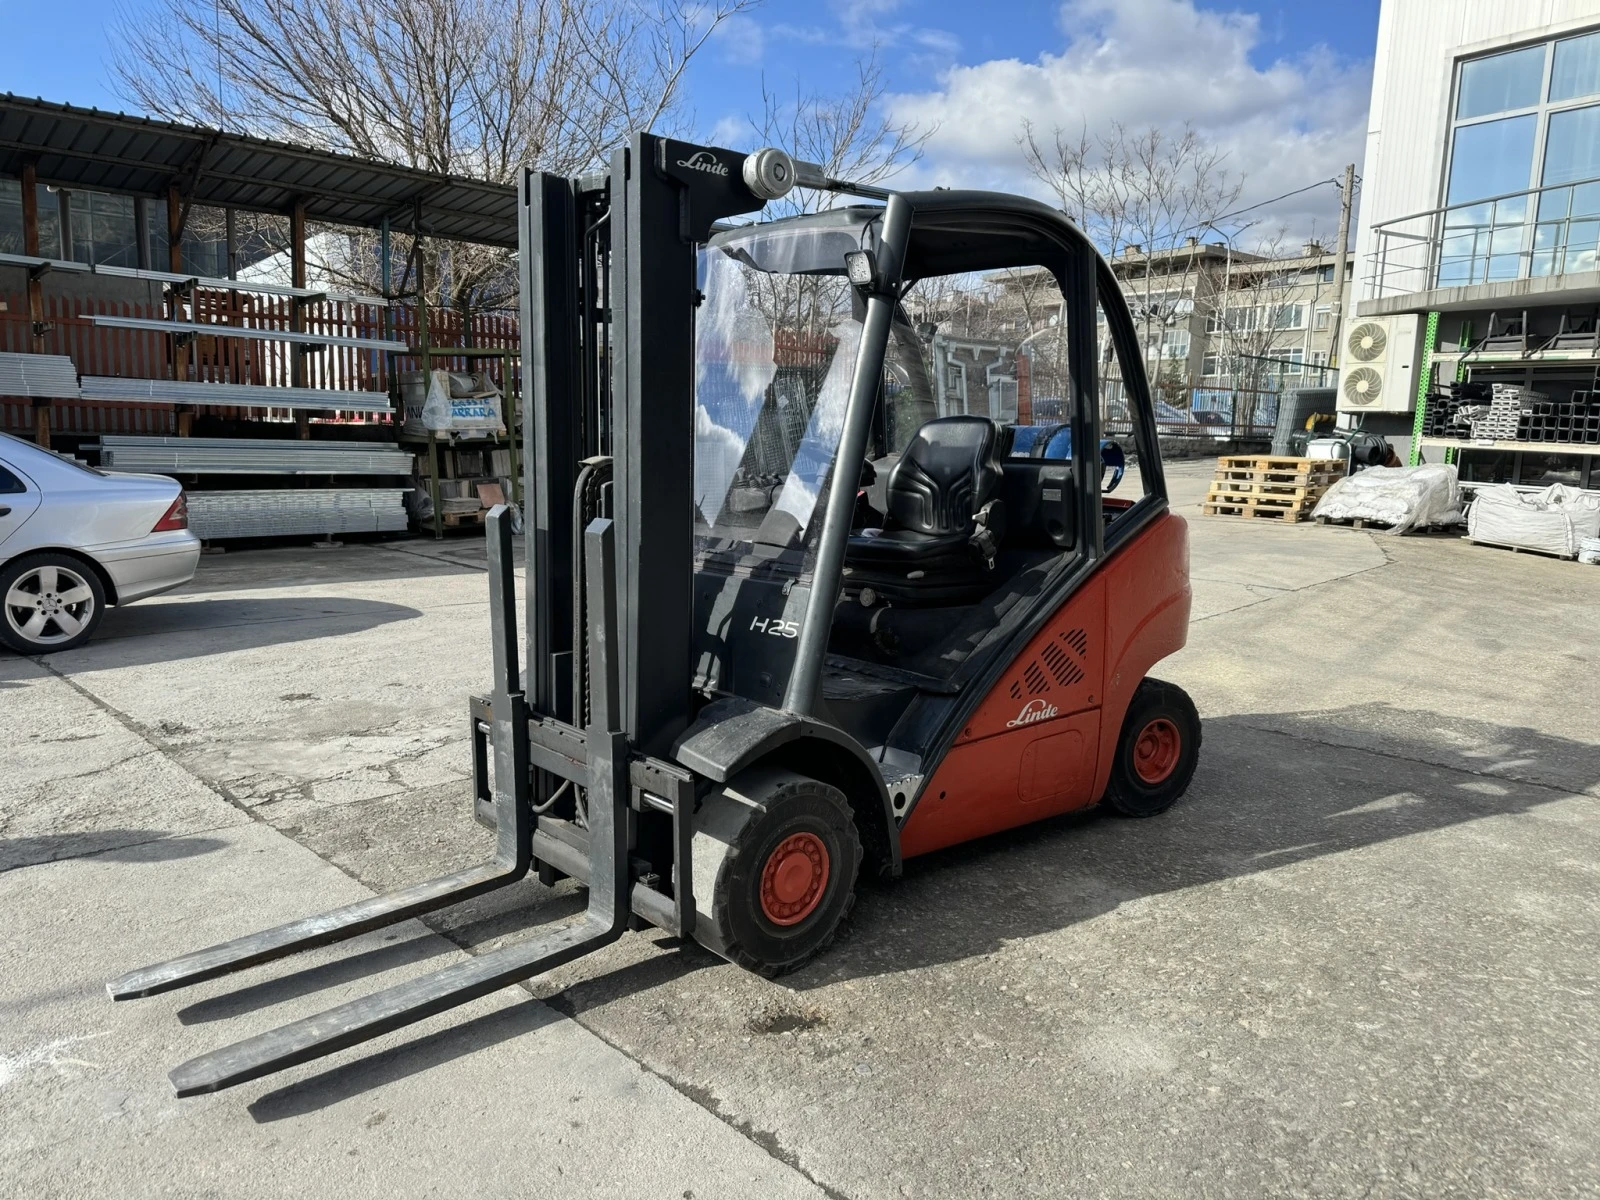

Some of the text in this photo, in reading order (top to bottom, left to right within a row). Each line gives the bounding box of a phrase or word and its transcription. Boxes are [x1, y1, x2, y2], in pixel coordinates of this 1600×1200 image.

[677, 152, 729, 176] Linde
[451, 407, 497, 418] ARRARA
[750, 616, 799, 638] H25
[1006, 699, 1058, 727] Linde
